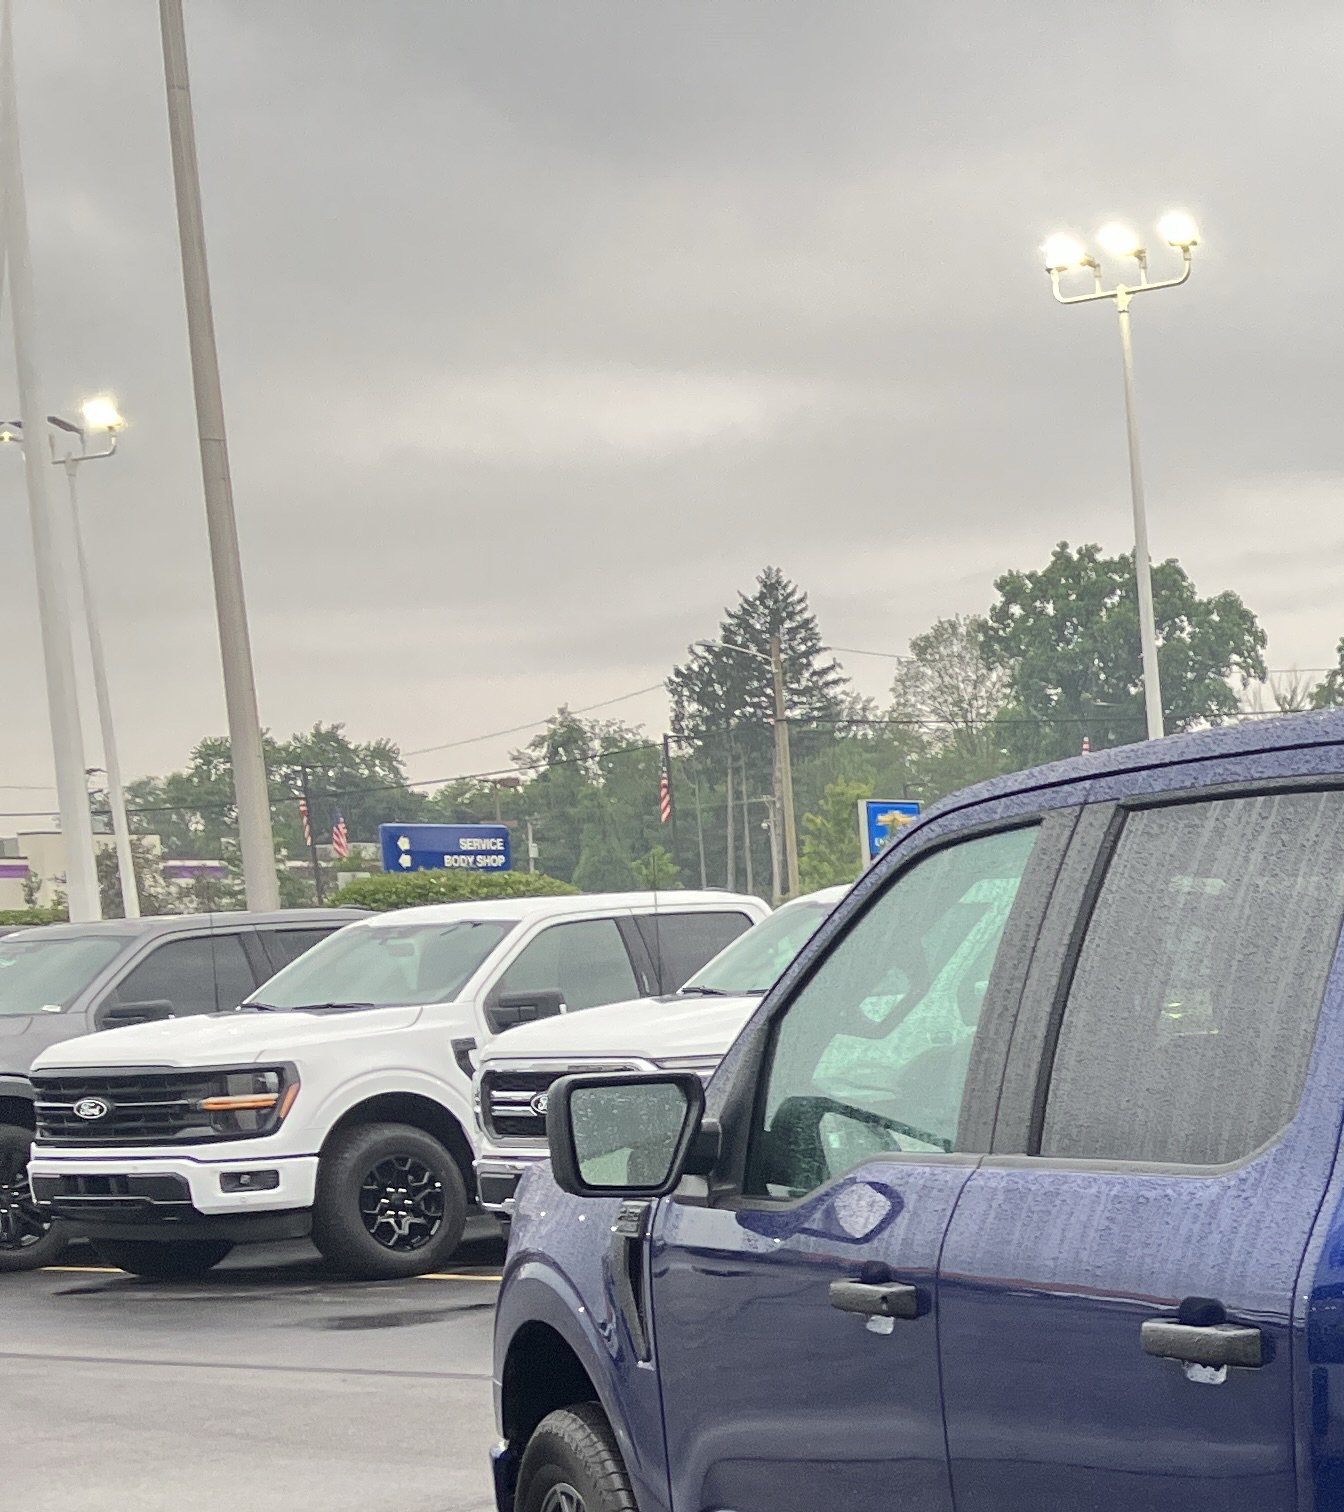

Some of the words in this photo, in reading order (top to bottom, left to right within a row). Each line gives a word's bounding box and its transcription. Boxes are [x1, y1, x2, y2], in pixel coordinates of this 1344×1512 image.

[459, 838, 504, 850] SERVICE
[443, 855, 474, 867] BODY
[475, 855, 506, 867] SHOP
